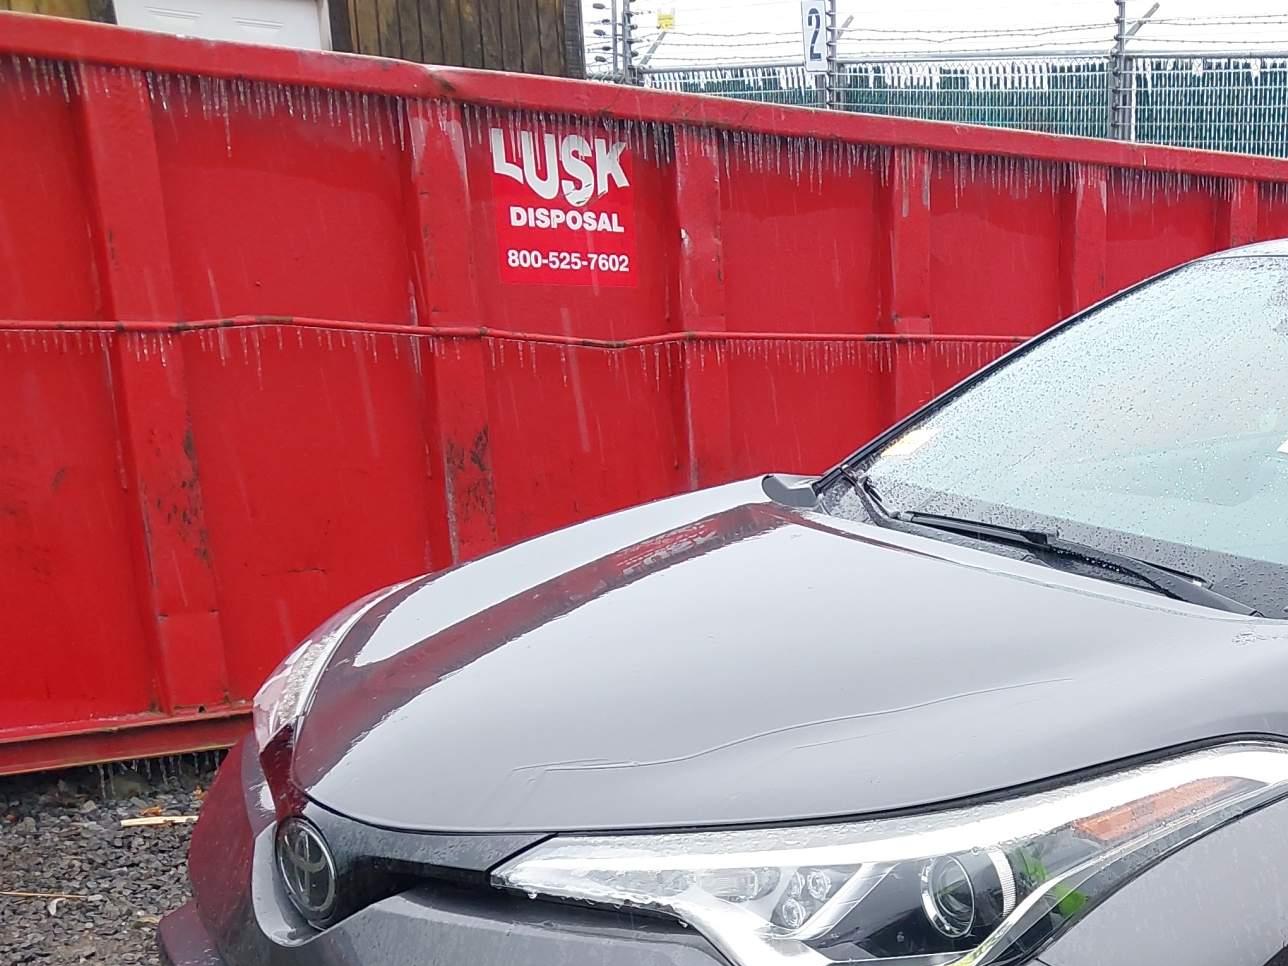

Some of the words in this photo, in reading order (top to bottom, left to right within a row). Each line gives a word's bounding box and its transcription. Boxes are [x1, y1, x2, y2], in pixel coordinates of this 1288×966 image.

[807, 8, 821, 61] 2
[490, 127, 630, 207] LUSK
[509, 206, 625, 233] DISPOSAL
[507, 249, 629, 272] 800-525-7602
